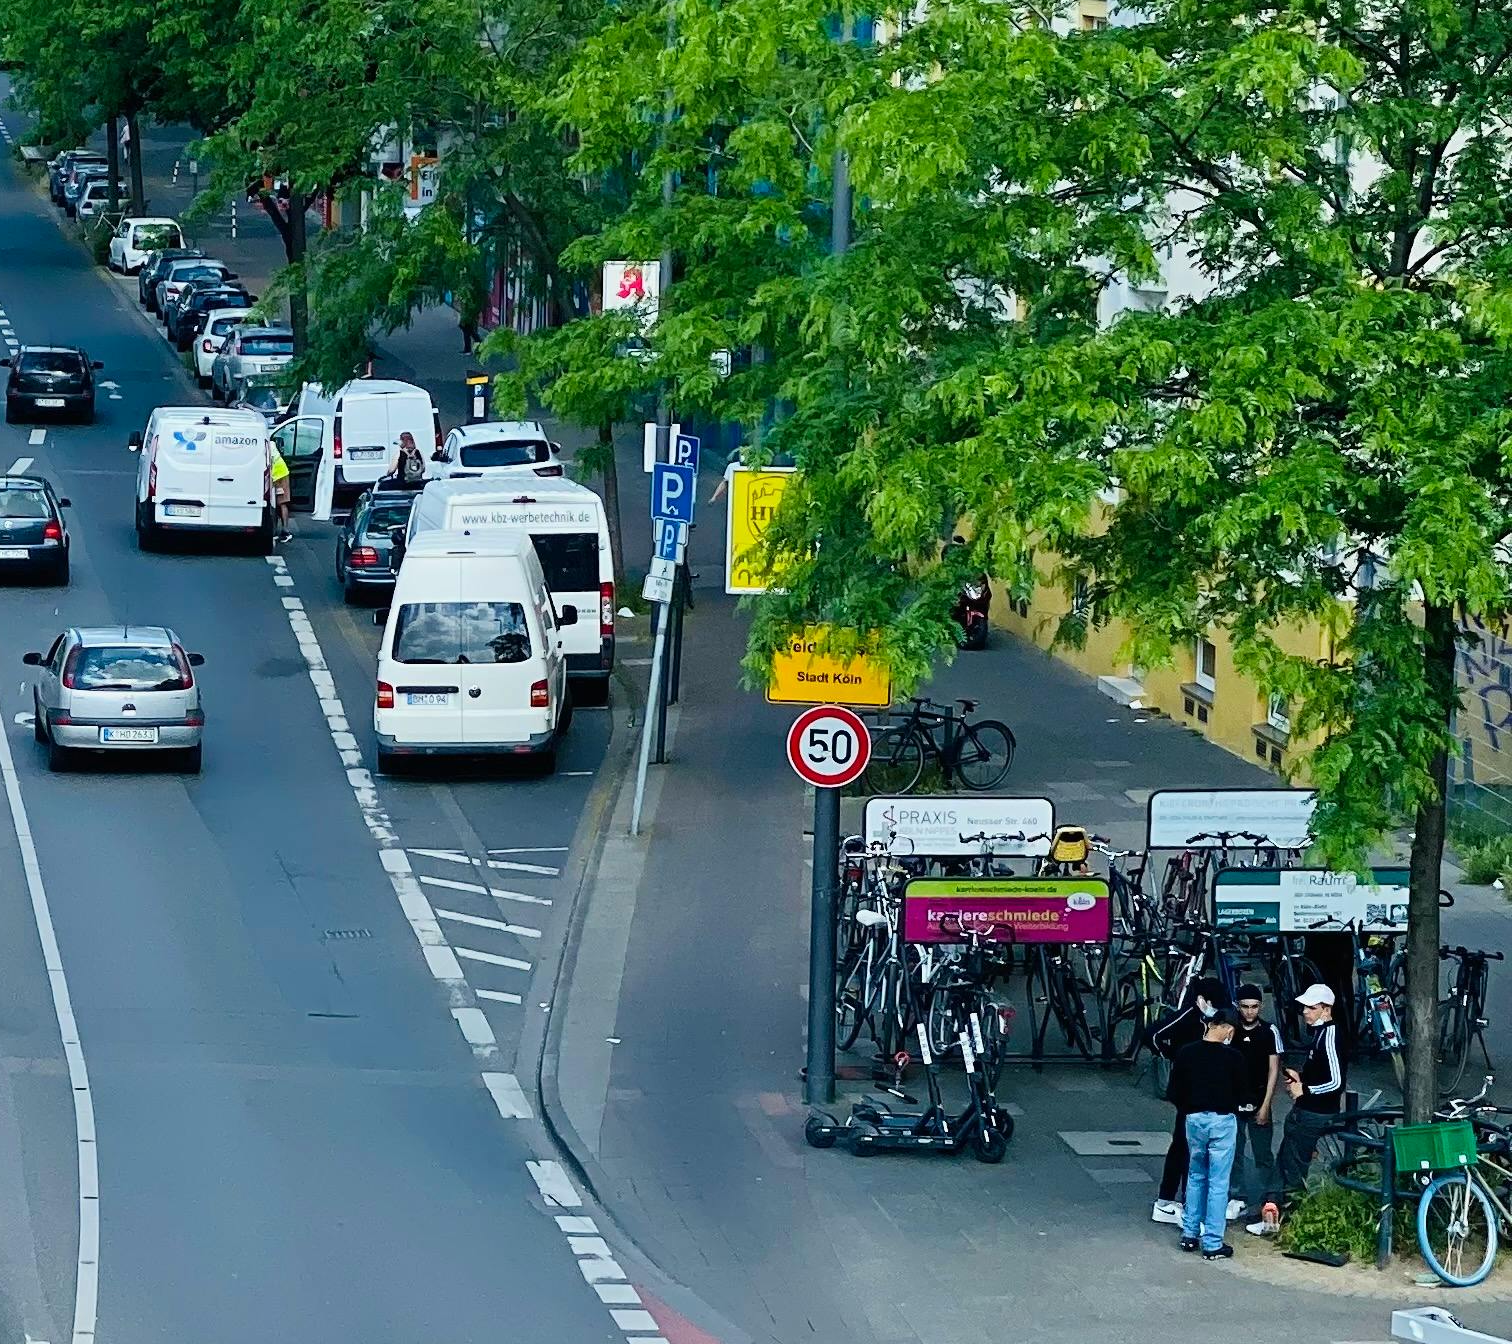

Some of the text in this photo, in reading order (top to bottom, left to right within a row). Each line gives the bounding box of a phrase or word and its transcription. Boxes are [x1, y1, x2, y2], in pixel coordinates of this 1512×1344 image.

[214, 435, 258, 446] amazon
[678, 439, 692, 463] P
[661, 471, 684, 515] P
[663, 524, 675, 556] P
[797, 671, 862, 685] Stadt Köln
[808, 728, 852, 765] 50
[899, 810, 957, 825] PRAXIS
